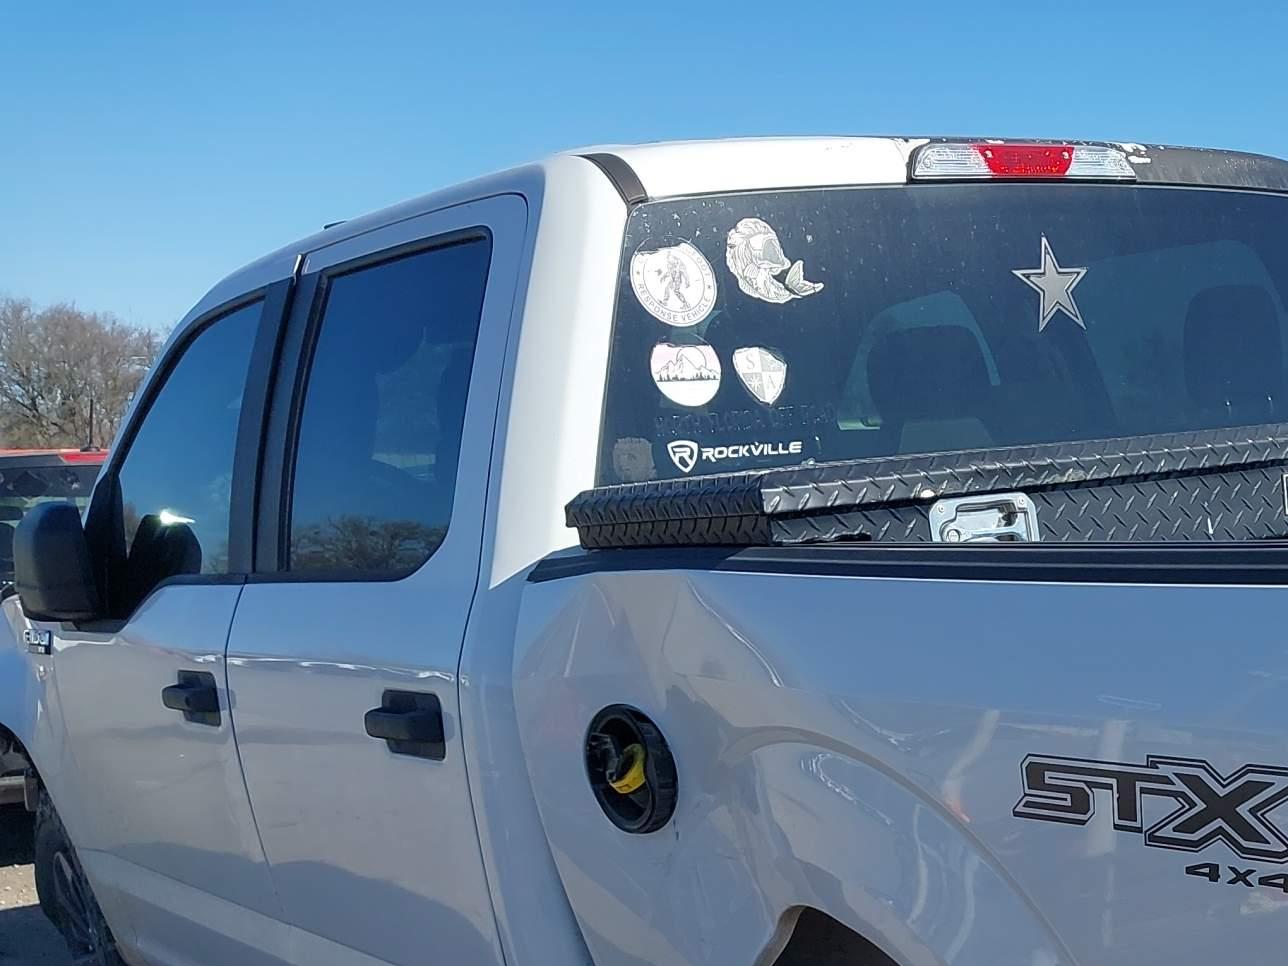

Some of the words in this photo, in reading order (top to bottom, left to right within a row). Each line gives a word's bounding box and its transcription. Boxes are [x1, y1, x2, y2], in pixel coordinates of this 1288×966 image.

[638, 283, 679, 321] RESPONSE
[681, 295, 712, 321] VEHICLE
[700, 441, 803, 463] ROCKVILLE
